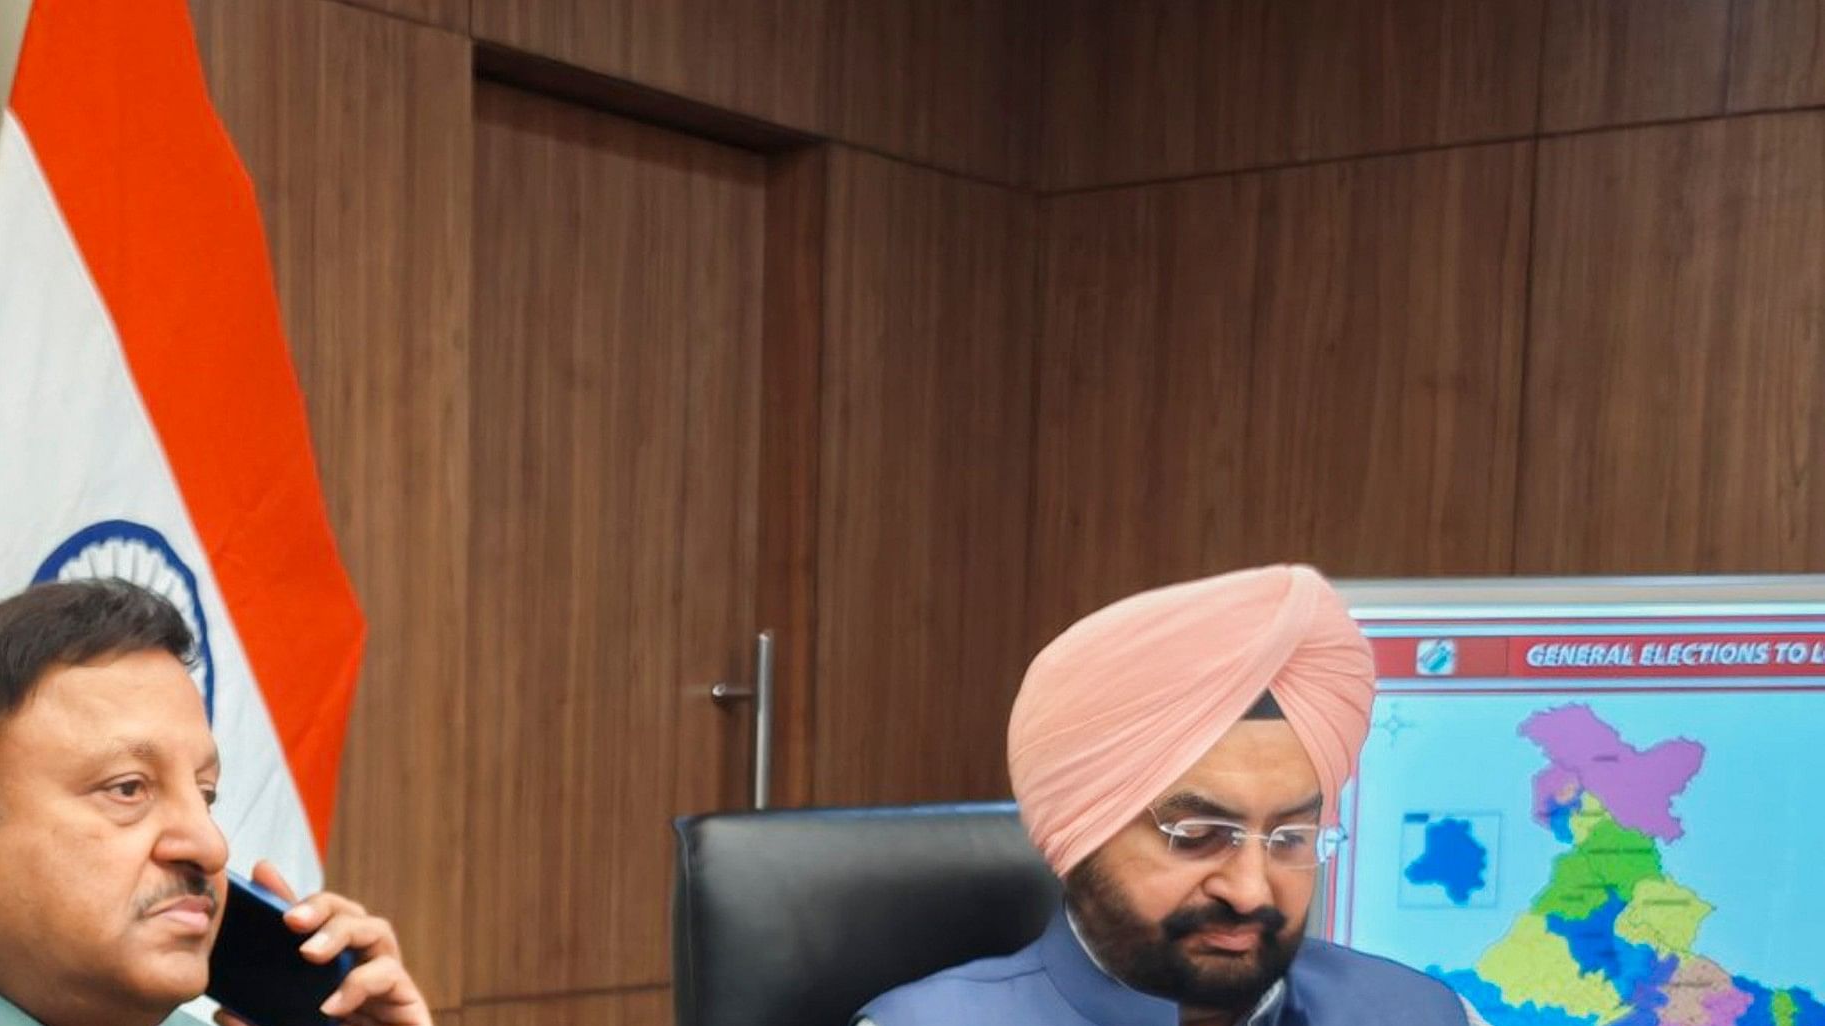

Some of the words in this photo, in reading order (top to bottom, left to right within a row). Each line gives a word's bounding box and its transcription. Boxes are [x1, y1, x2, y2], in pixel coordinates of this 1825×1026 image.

[1526, 643, 1634, 667] GENERAL
[1639, 641, 1771, 665] ELECTIONS
[1775, 641, 1809, 665] TO
